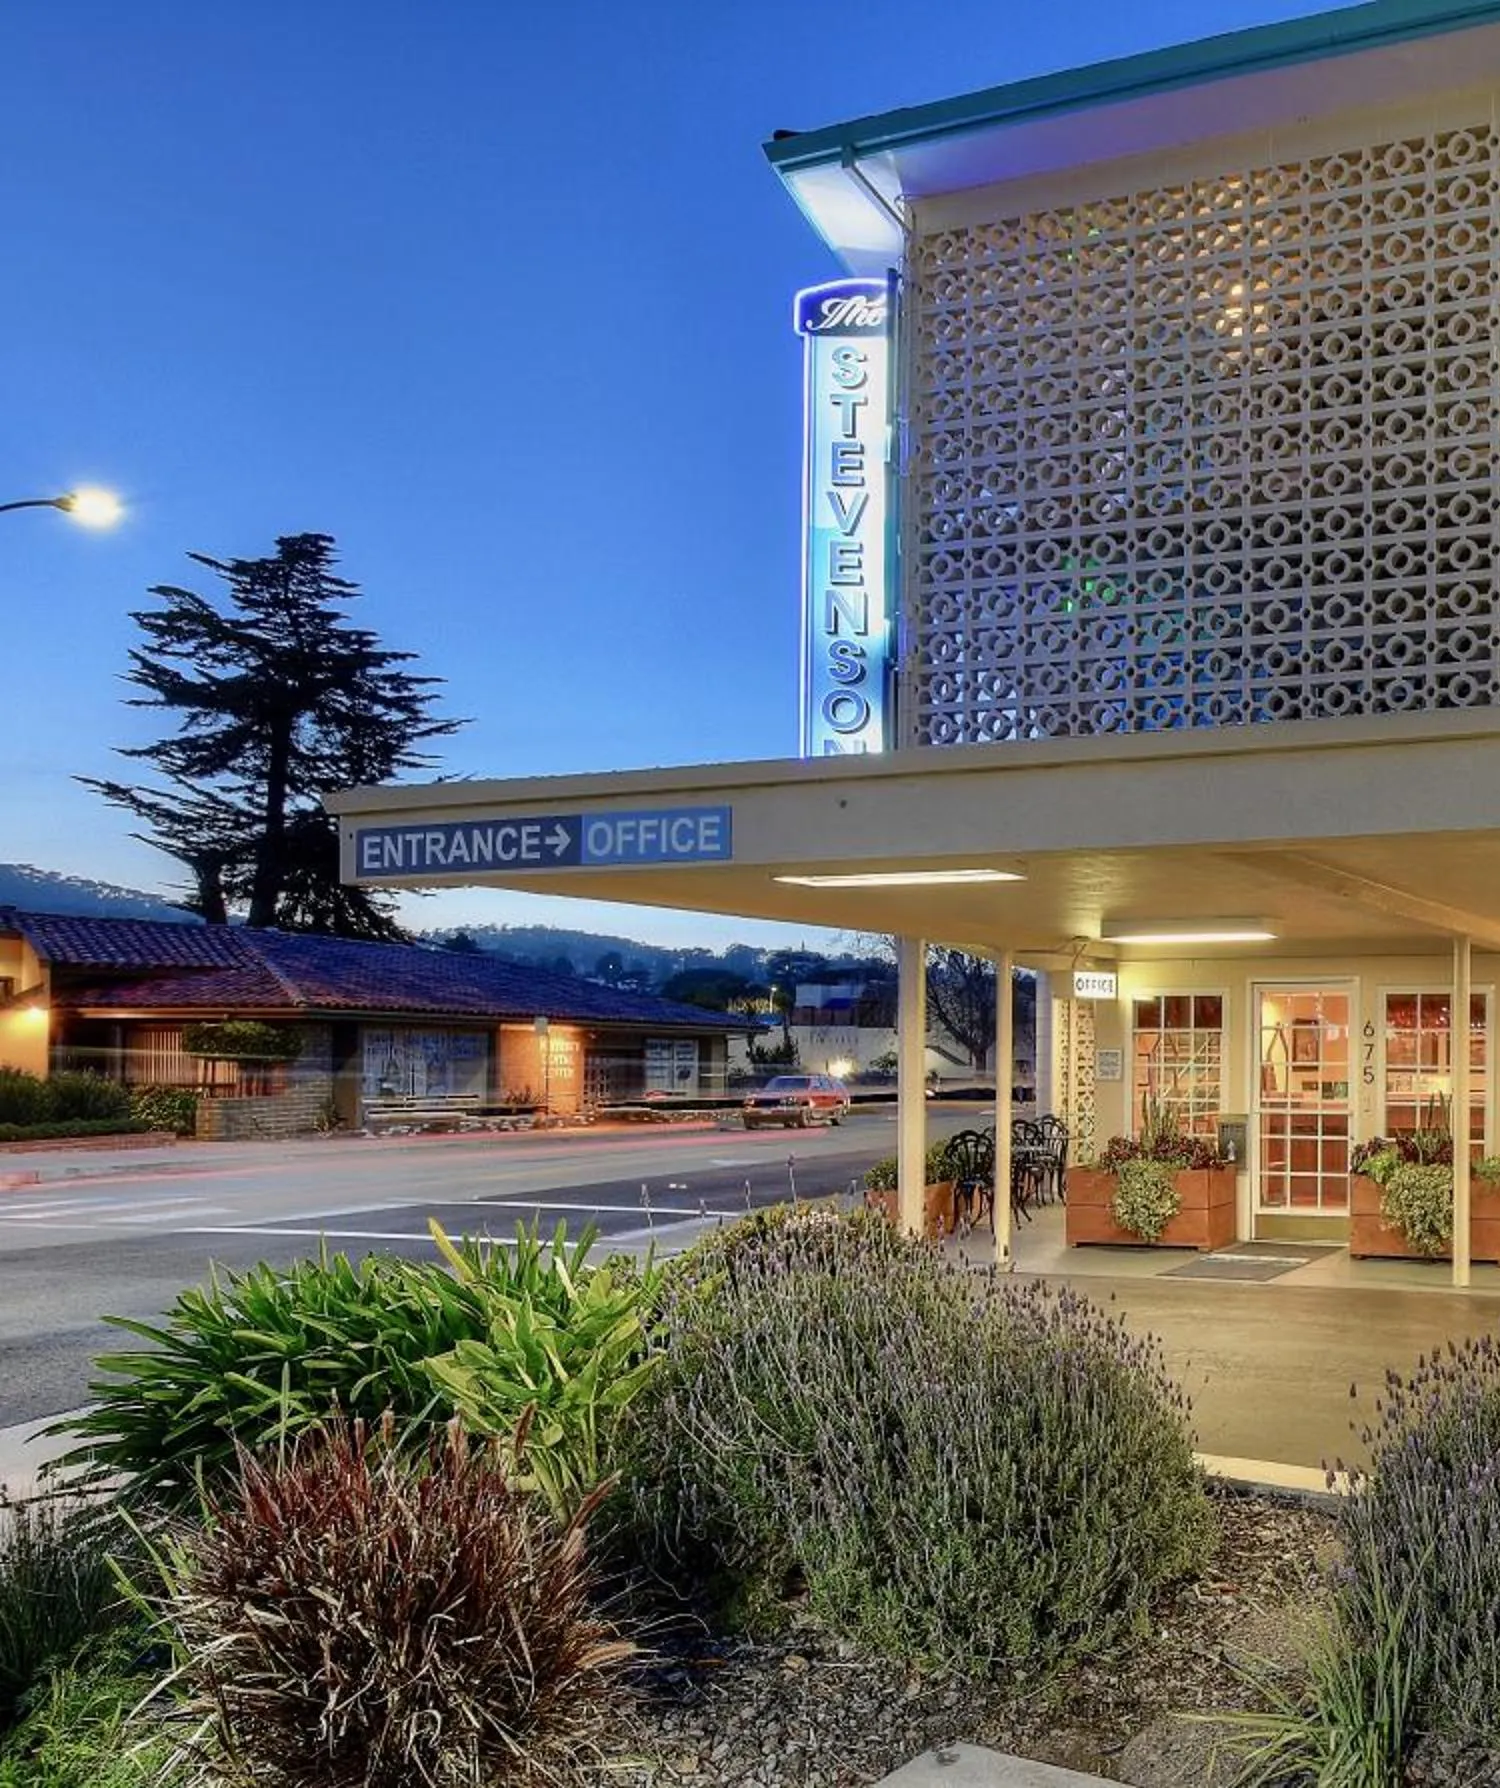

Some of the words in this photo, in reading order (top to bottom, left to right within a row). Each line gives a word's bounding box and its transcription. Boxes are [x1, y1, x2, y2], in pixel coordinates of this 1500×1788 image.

[362, 825, 542, 870] ENTRANCE
[587, 814, 722, 858] OFFICE
[1075, 977, 1114, 993] OFFICE
[1362, 1019, 1376, 1085] 675
